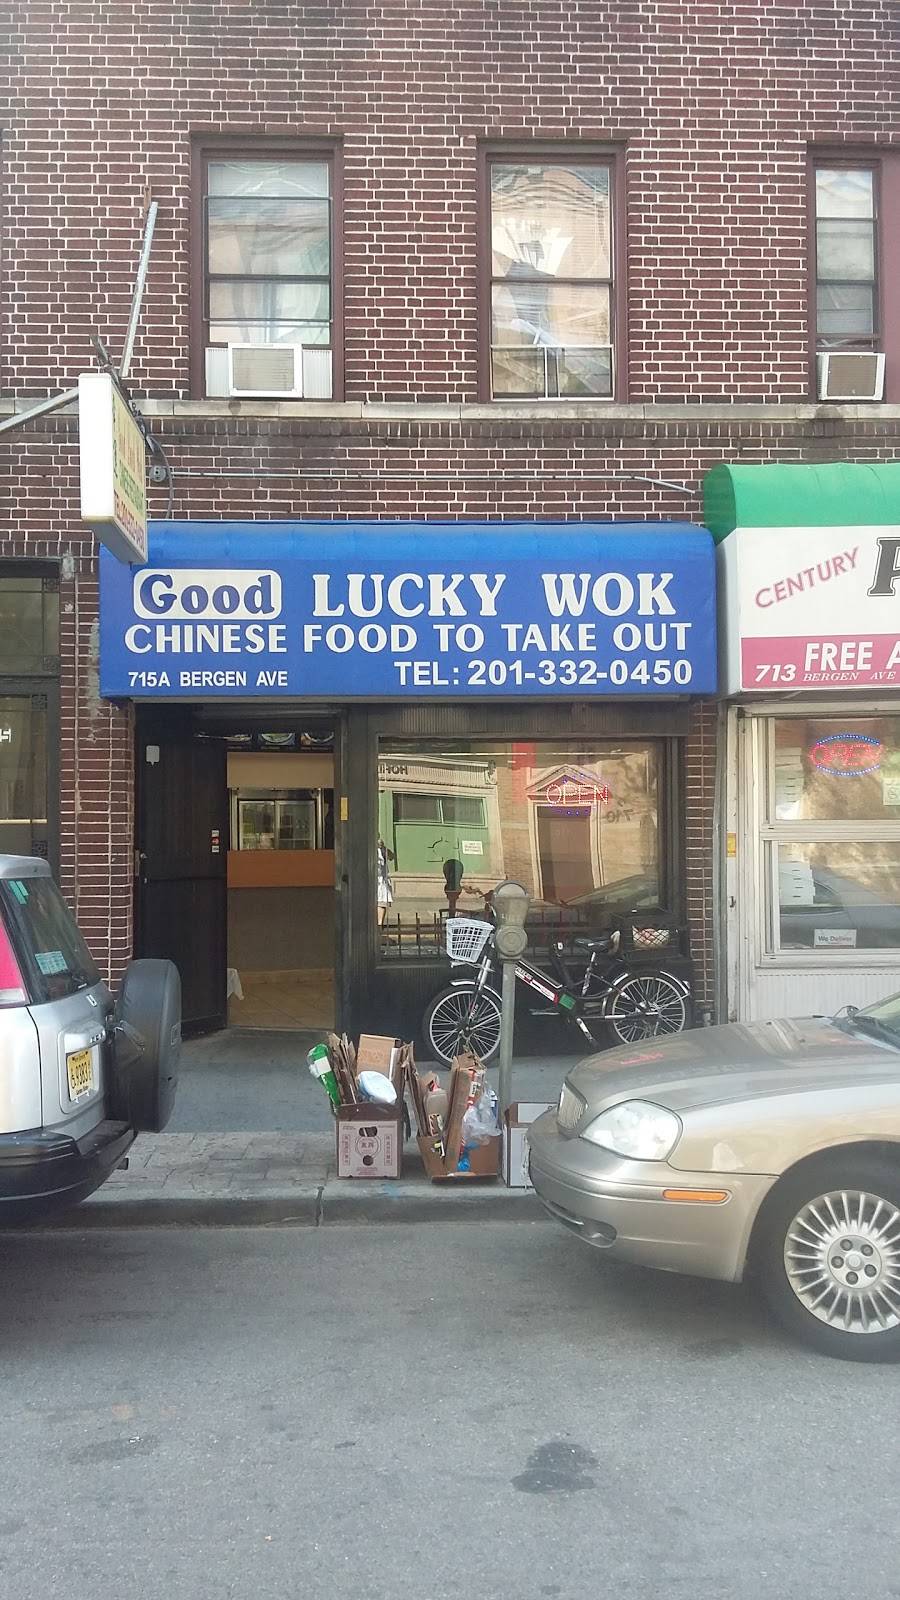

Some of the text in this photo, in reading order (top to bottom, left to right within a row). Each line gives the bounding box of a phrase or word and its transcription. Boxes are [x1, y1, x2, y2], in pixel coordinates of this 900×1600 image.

[754, 546, 860, 609] CENTURY
[139, 572, 677, 618] Good LUCKY WOK
[124, 622, 693, 654] CHINESE FOOD TO TAKE OUT
[804, 641, 873, 672] FREE
[128, 670, 288, 688] 715A BERGEN AVE
[394, 658, 693, 686] TEL: 201-332-0450
[754, 663, 797, 682] 713
[803, 671, 897, 682] BERGEN AVE
[546, 783, 608, 804] OPEN
